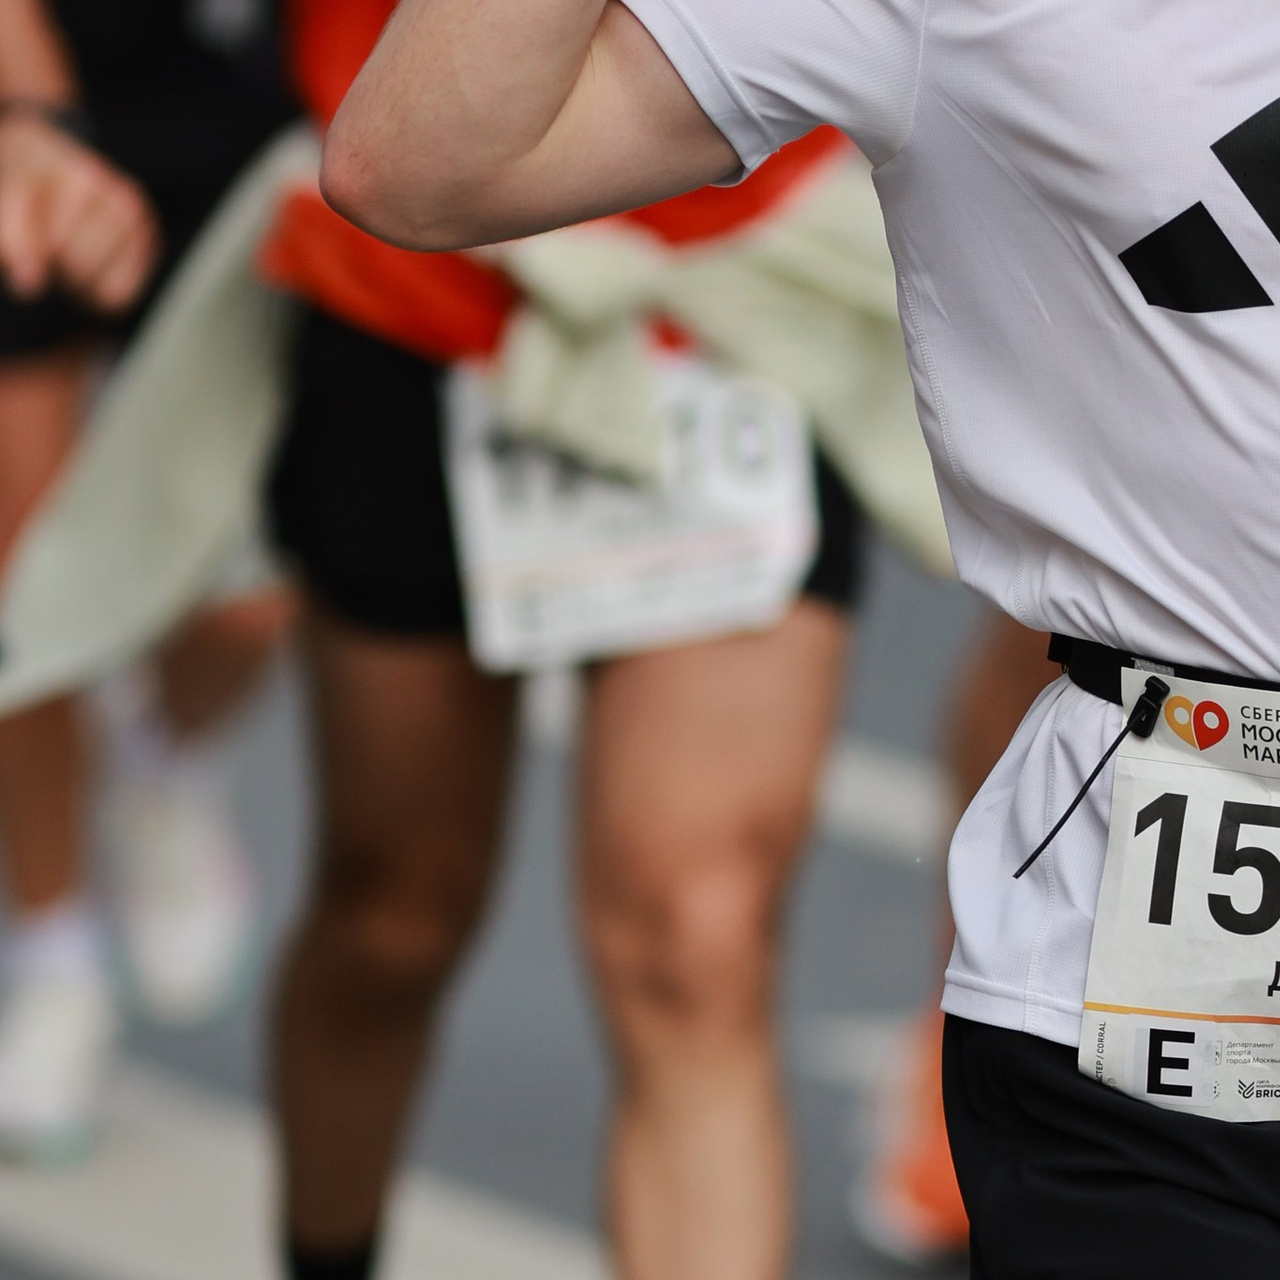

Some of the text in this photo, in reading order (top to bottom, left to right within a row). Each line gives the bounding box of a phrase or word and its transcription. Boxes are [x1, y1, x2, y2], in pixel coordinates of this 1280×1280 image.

[1096, 1022, 1106, 1054] CORRAL
[1226, 1041, 1274, 1049] Департамент
[1095, 1060, 1104, 1082] СТЕР
